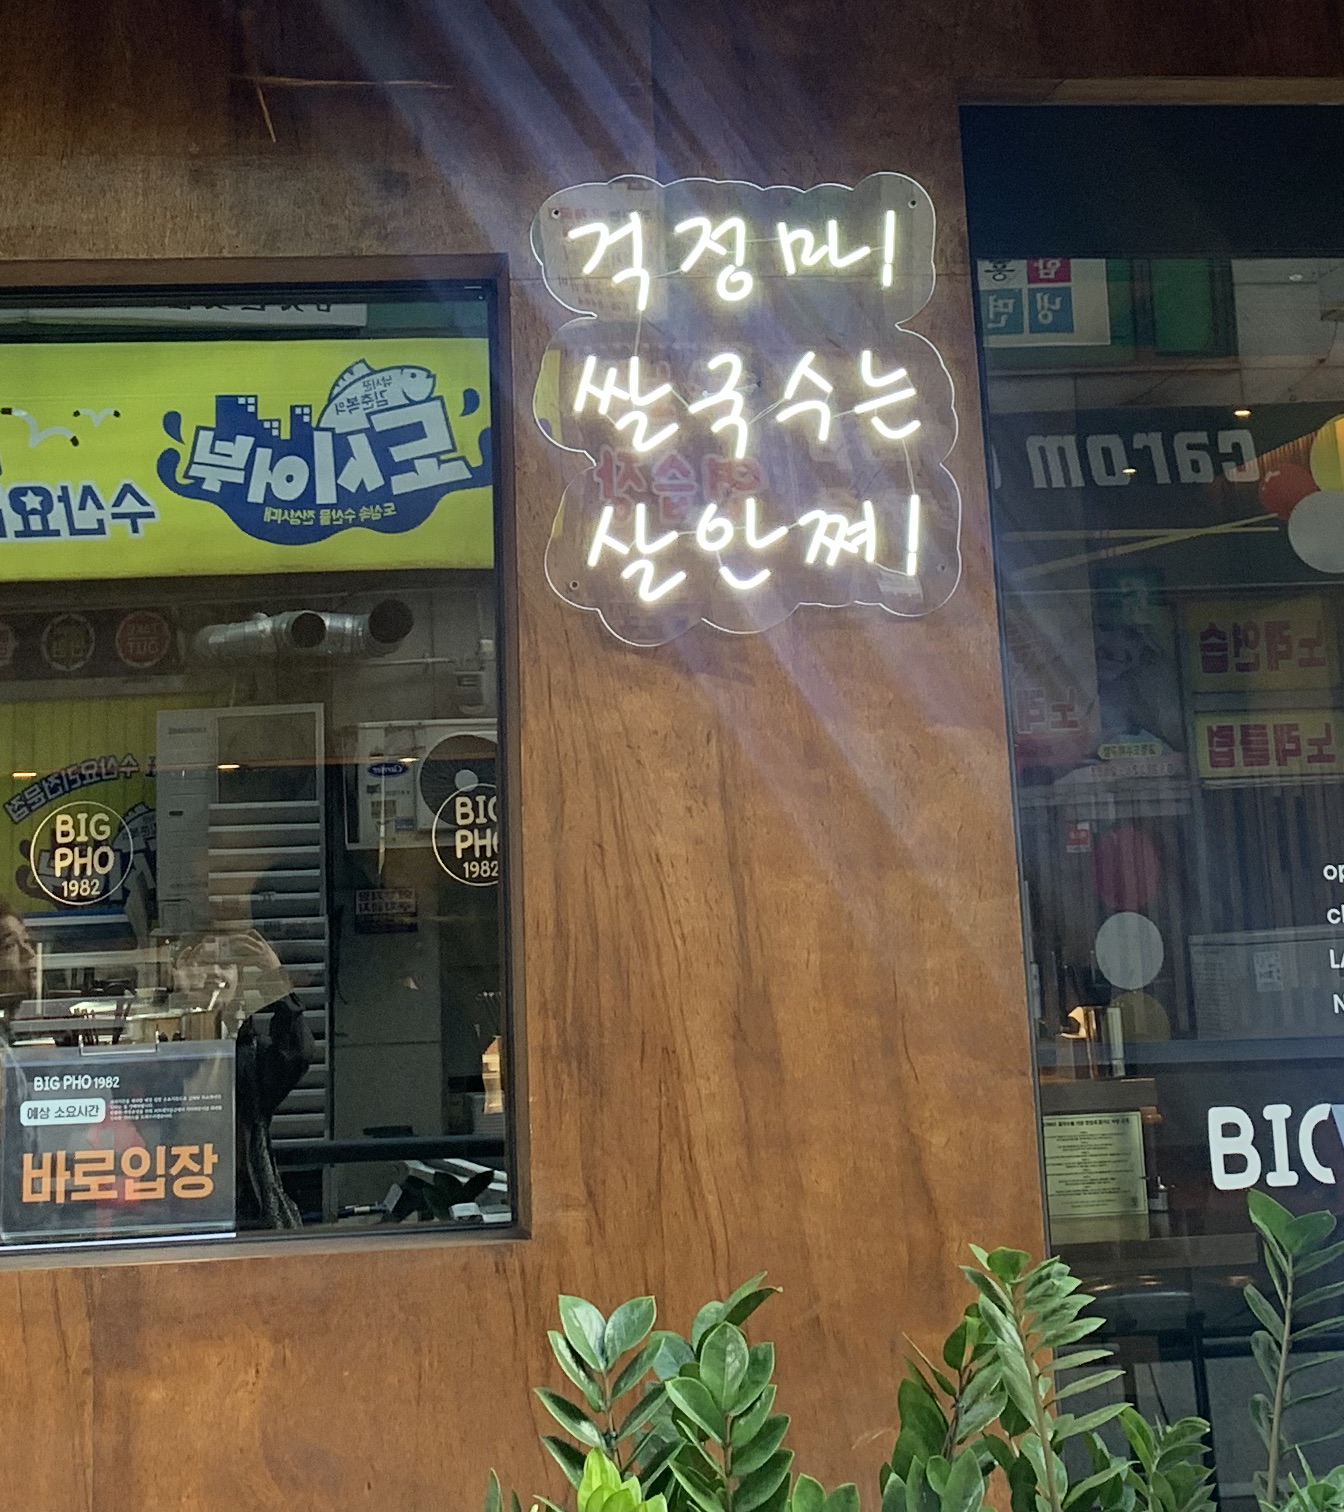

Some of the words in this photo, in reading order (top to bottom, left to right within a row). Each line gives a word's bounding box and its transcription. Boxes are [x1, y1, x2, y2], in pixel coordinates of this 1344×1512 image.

[574, 350, 921, 458] 쌀국수는
[55, 812, 112, 844] BIG
[455, 828, 499, 859] PH
[53, 845, 116, 878] PHO
[60, 878, 101, 898] 1982
[33, 1075, 61, 1092] BIG
[63, 1074, 92, 1090] PHO
[93, 1076, 120, 1090] 1982
[27, 1107, 50, 1120] 예상
[54, 1105, 99, 1119] 소요시간
[21, 1143, 219, 1204] 바로입장
